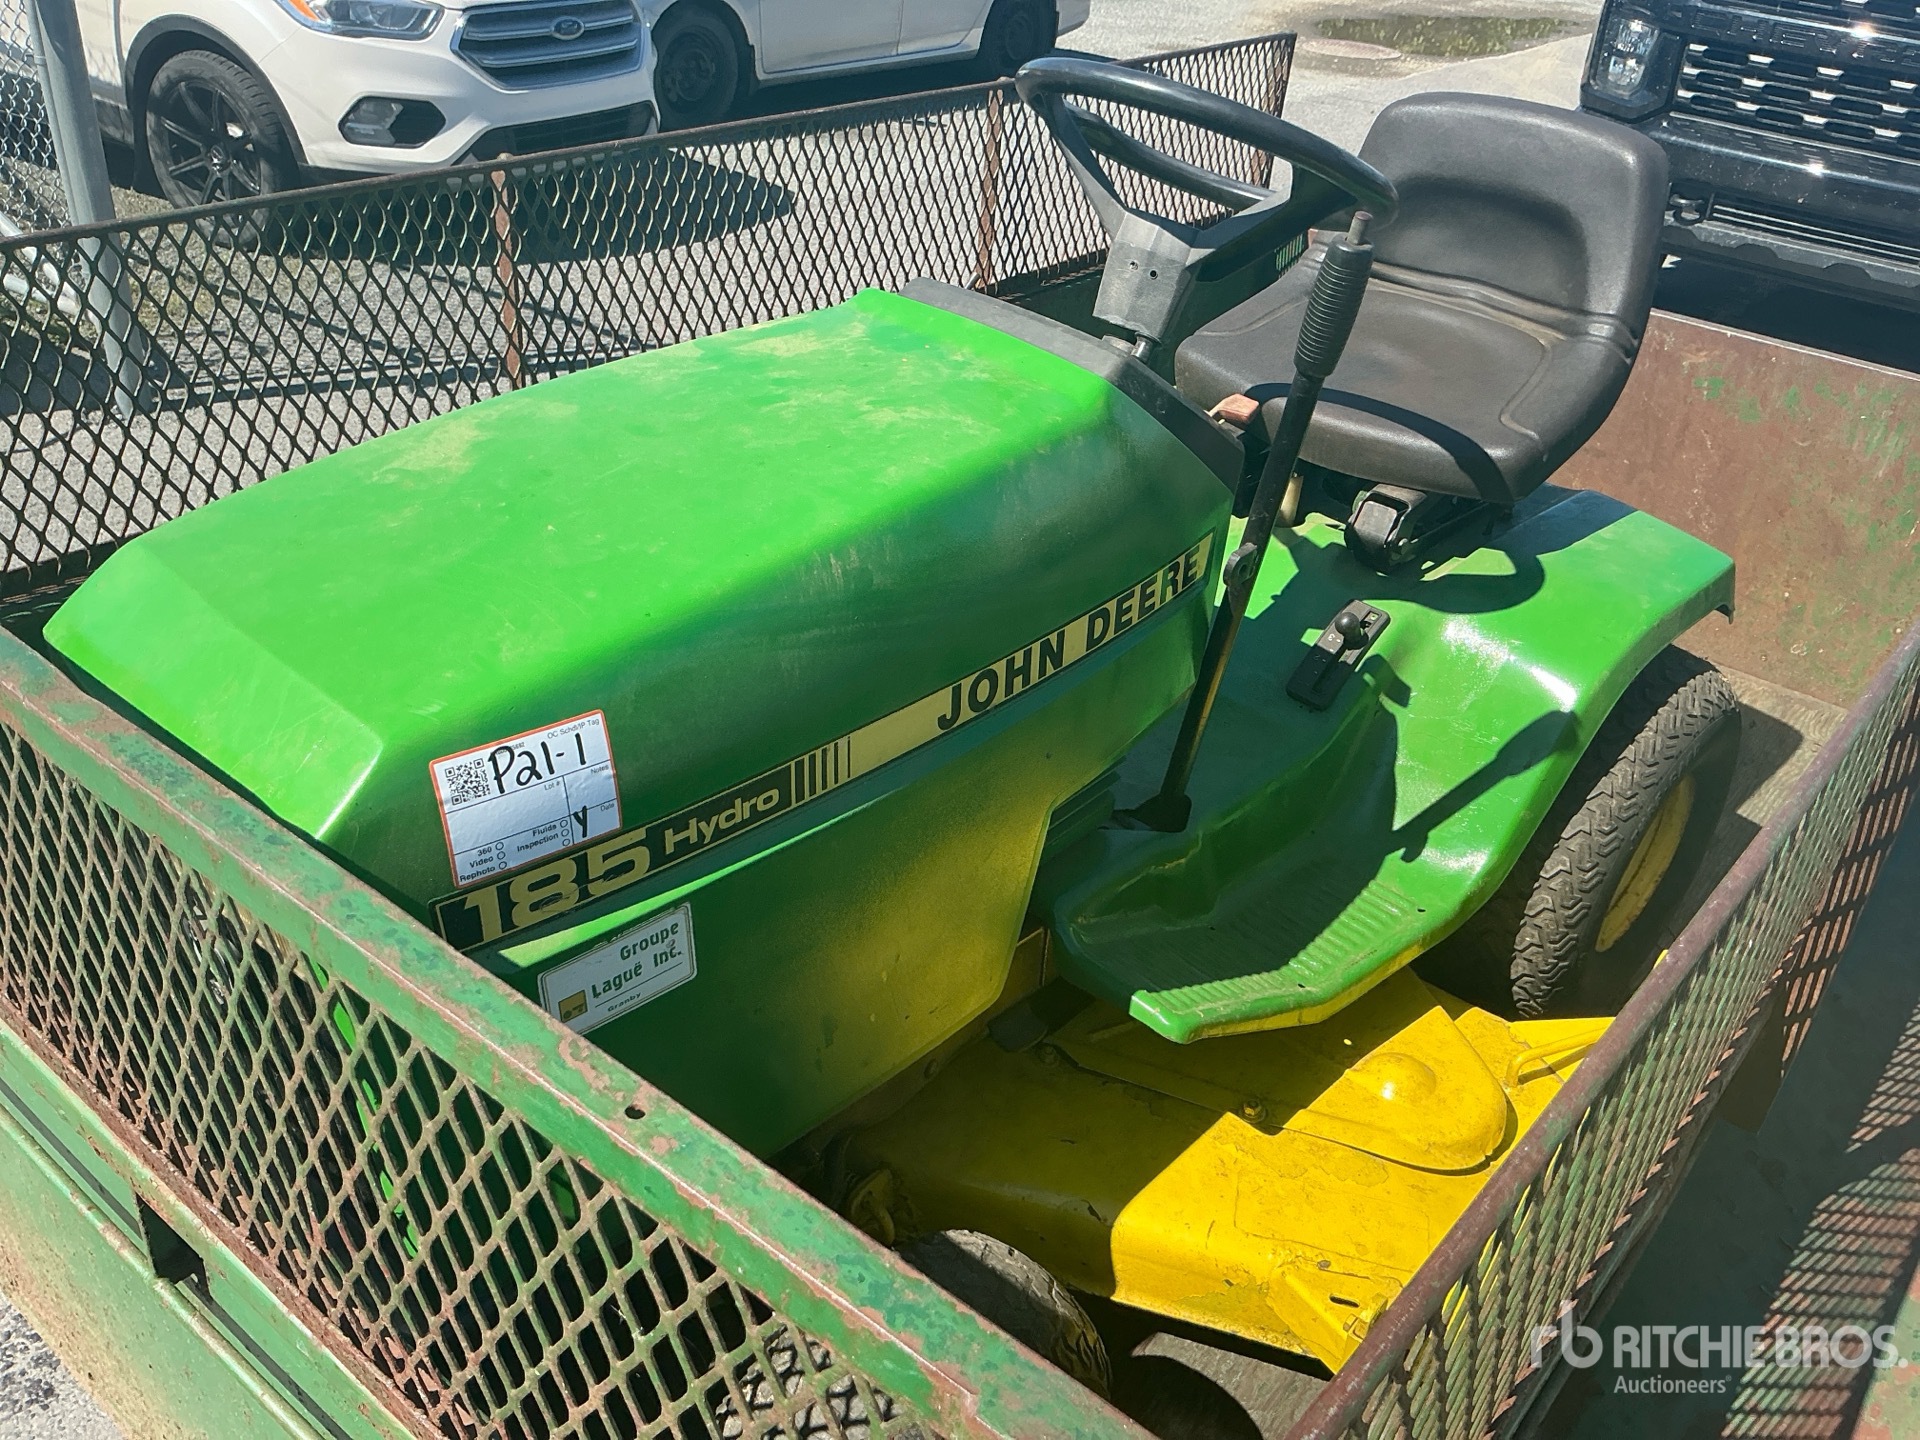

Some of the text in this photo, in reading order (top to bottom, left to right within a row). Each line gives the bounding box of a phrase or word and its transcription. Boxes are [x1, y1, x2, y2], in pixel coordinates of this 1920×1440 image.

[937, 543, 1201, 731] JOHN DEERE
[588, 718, 600, 726] Tag
[590, 764, 609, 774] Notes
[544, 782, 555, 791] Lot
[600, 802, 615, 812] Date
[532, 825, 557, 837] Fluids
[517, 833, 559, 852] Inspection
[477, 847, 492, 857] 360
[464, 787, 780, 943] 185 Hydro
[469, 856, 494, 868] Video
[459, 866, 496, 882] Rephoto
[620, 922, 679, 961] Groupe
[591, 945, 683, 999] Laguë Inc.
[607, 992, 642, 1012] Granby
